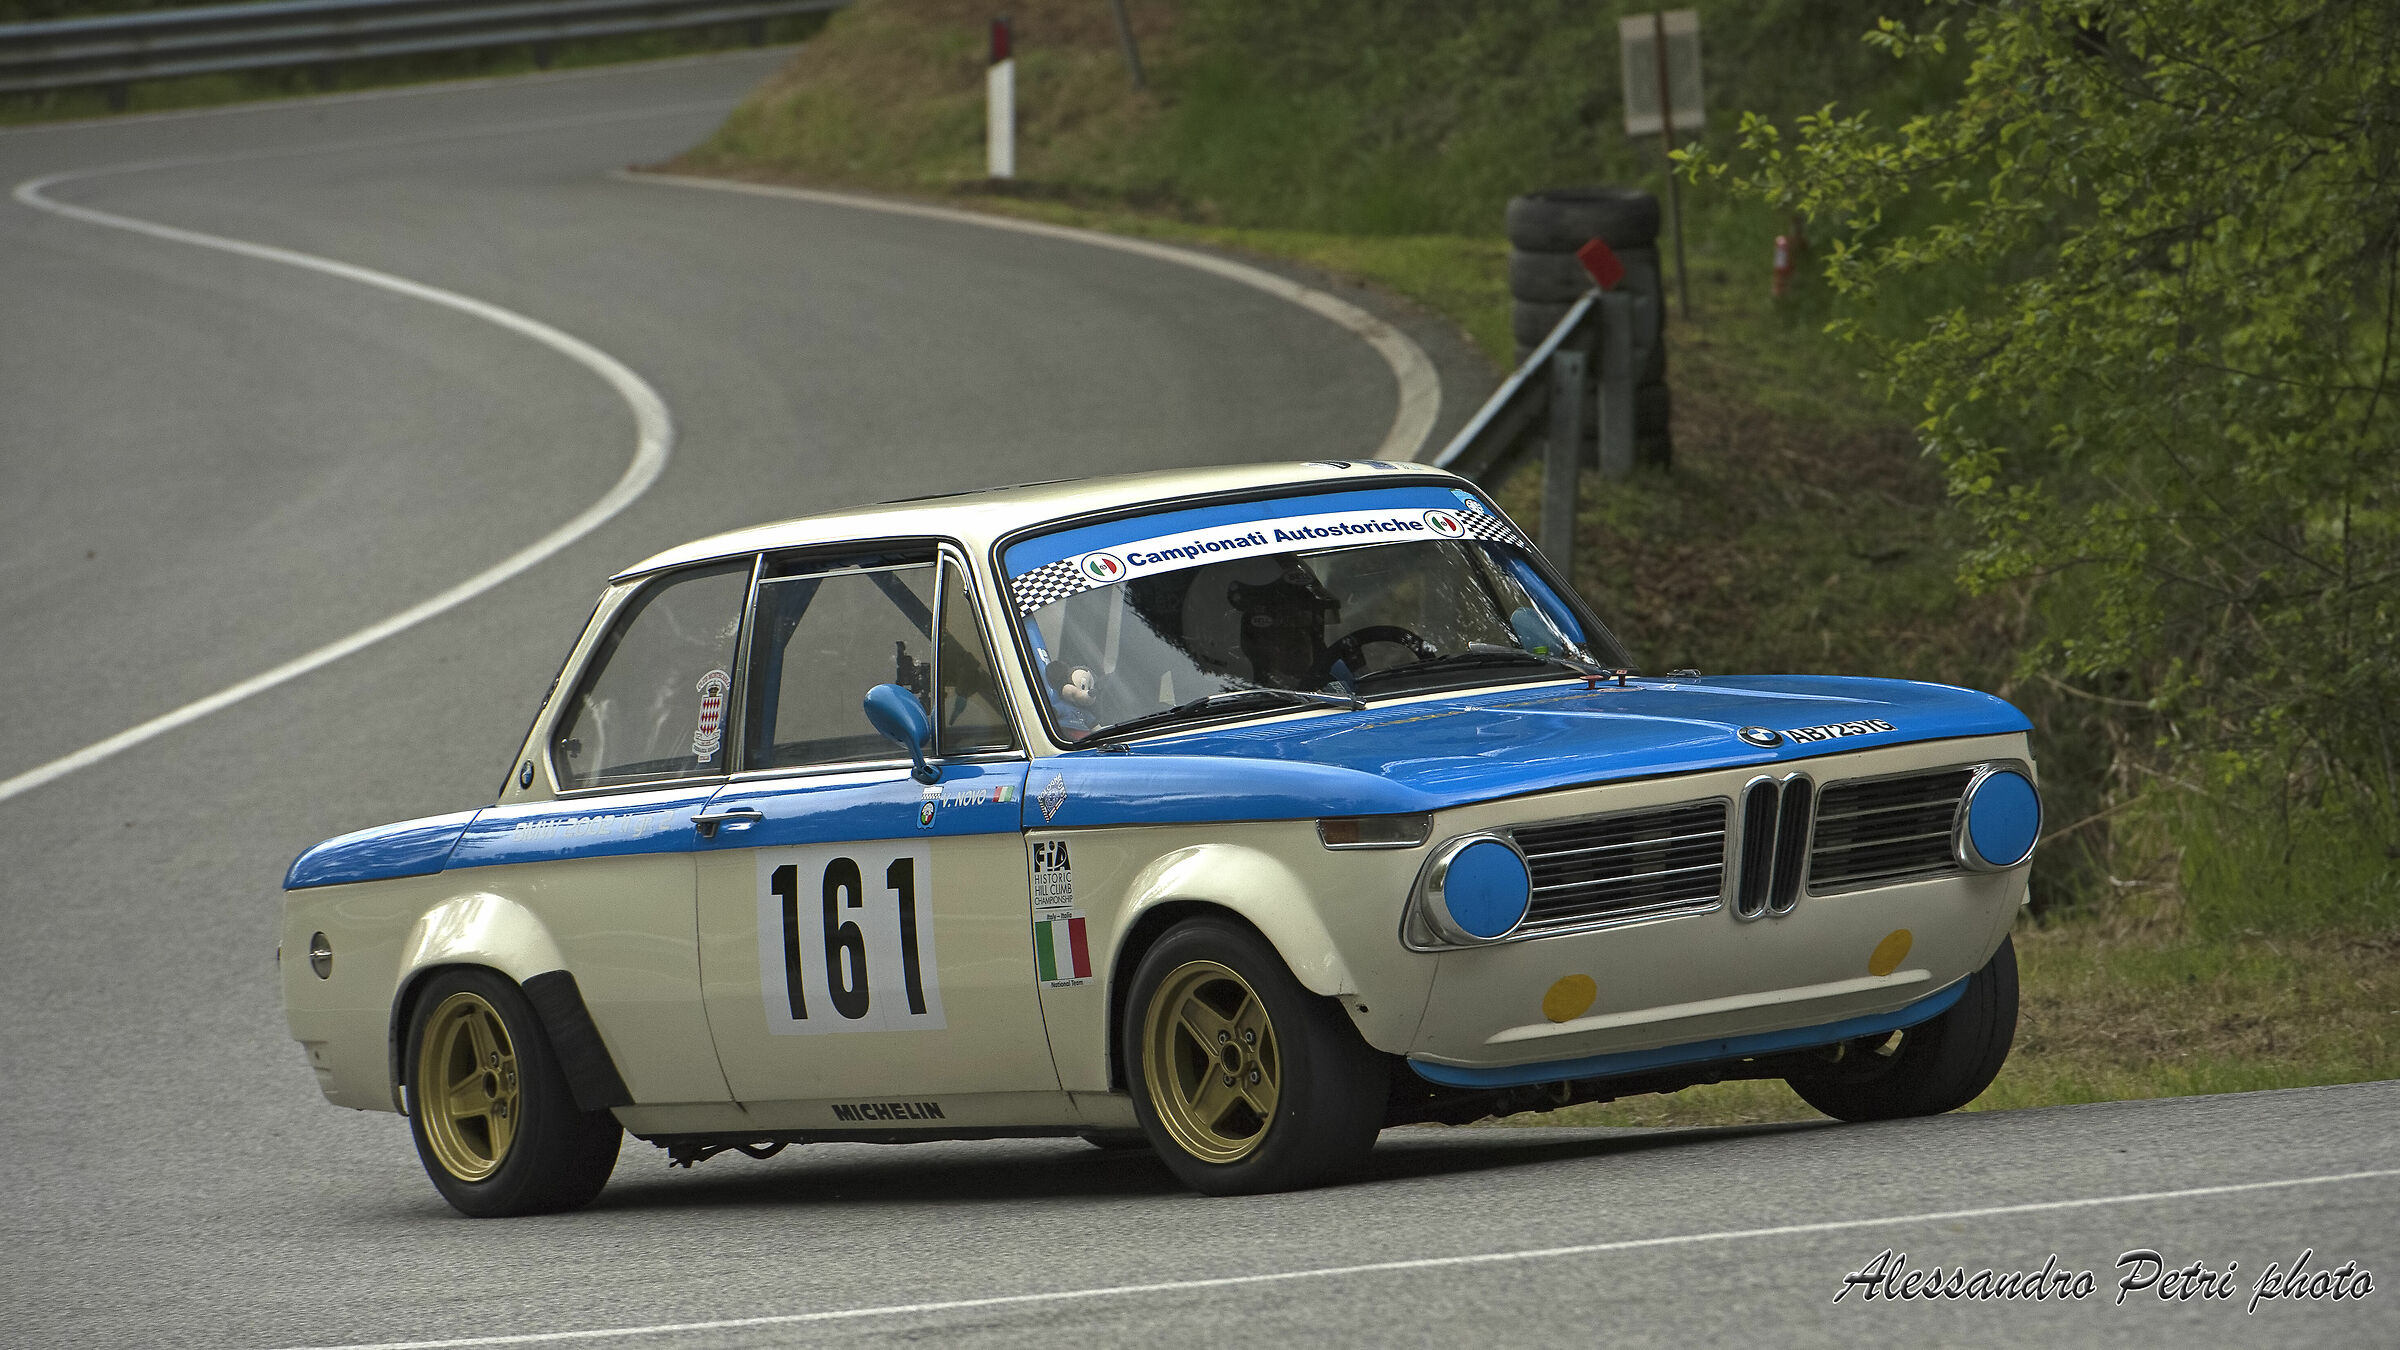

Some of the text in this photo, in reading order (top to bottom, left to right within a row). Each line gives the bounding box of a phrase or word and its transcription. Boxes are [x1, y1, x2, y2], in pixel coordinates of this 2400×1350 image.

[1127, 518, 1424, 567] Campionati Autostoriche
[942, 789, 987, 808] V. NOVO
[513, 819, 562, 841] BMW
[564, 814, 616, 838] 2002
[658, 810, 675, 830] 2
[1034, 872, 1072, 884] HISTORIC
[1034, 883, 1072, 896] HILL CLIMB
[1034, 895, 1073, 906] CHAMPIONSHIP
[771, 857, 927, 1020] 161
[1051, 980, 1070, 988] National
[831, 1102, 946, 1121] MICHELIN
